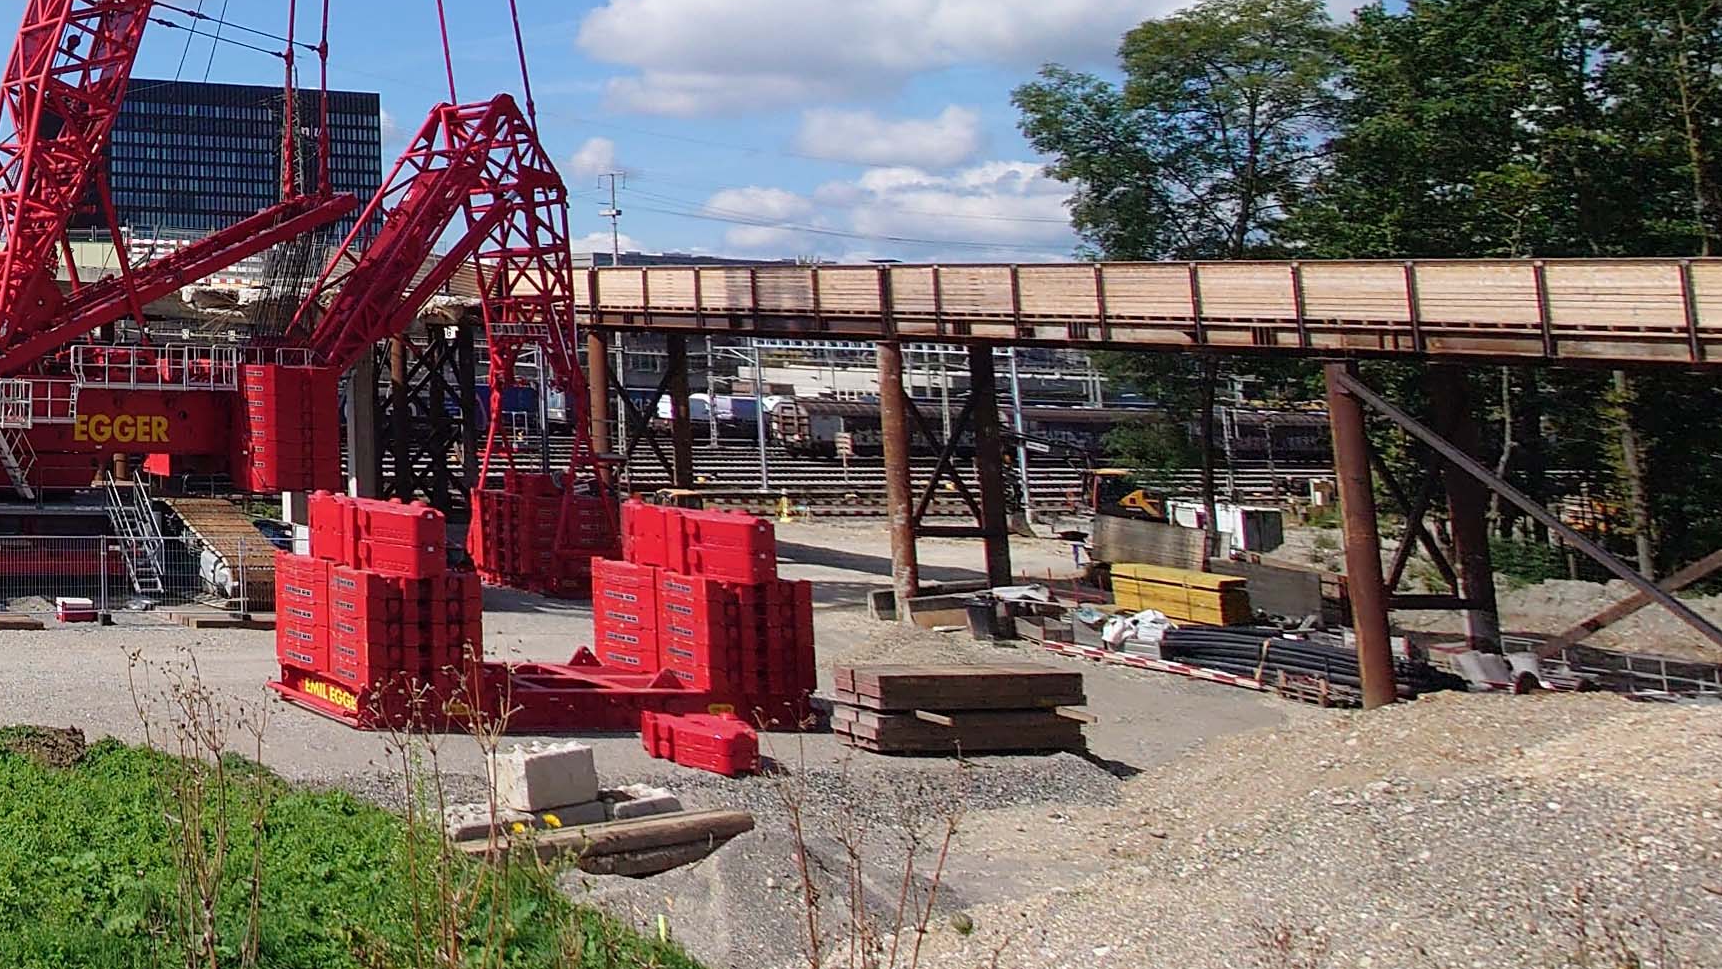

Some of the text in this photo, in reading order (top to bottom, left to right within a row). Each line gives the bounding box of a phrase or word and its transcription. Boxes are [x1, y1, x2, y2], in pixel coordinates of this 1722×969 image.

[74, 414, 170, 443] EGGER
[305, 678, 357, 711] EMIL EGGE
